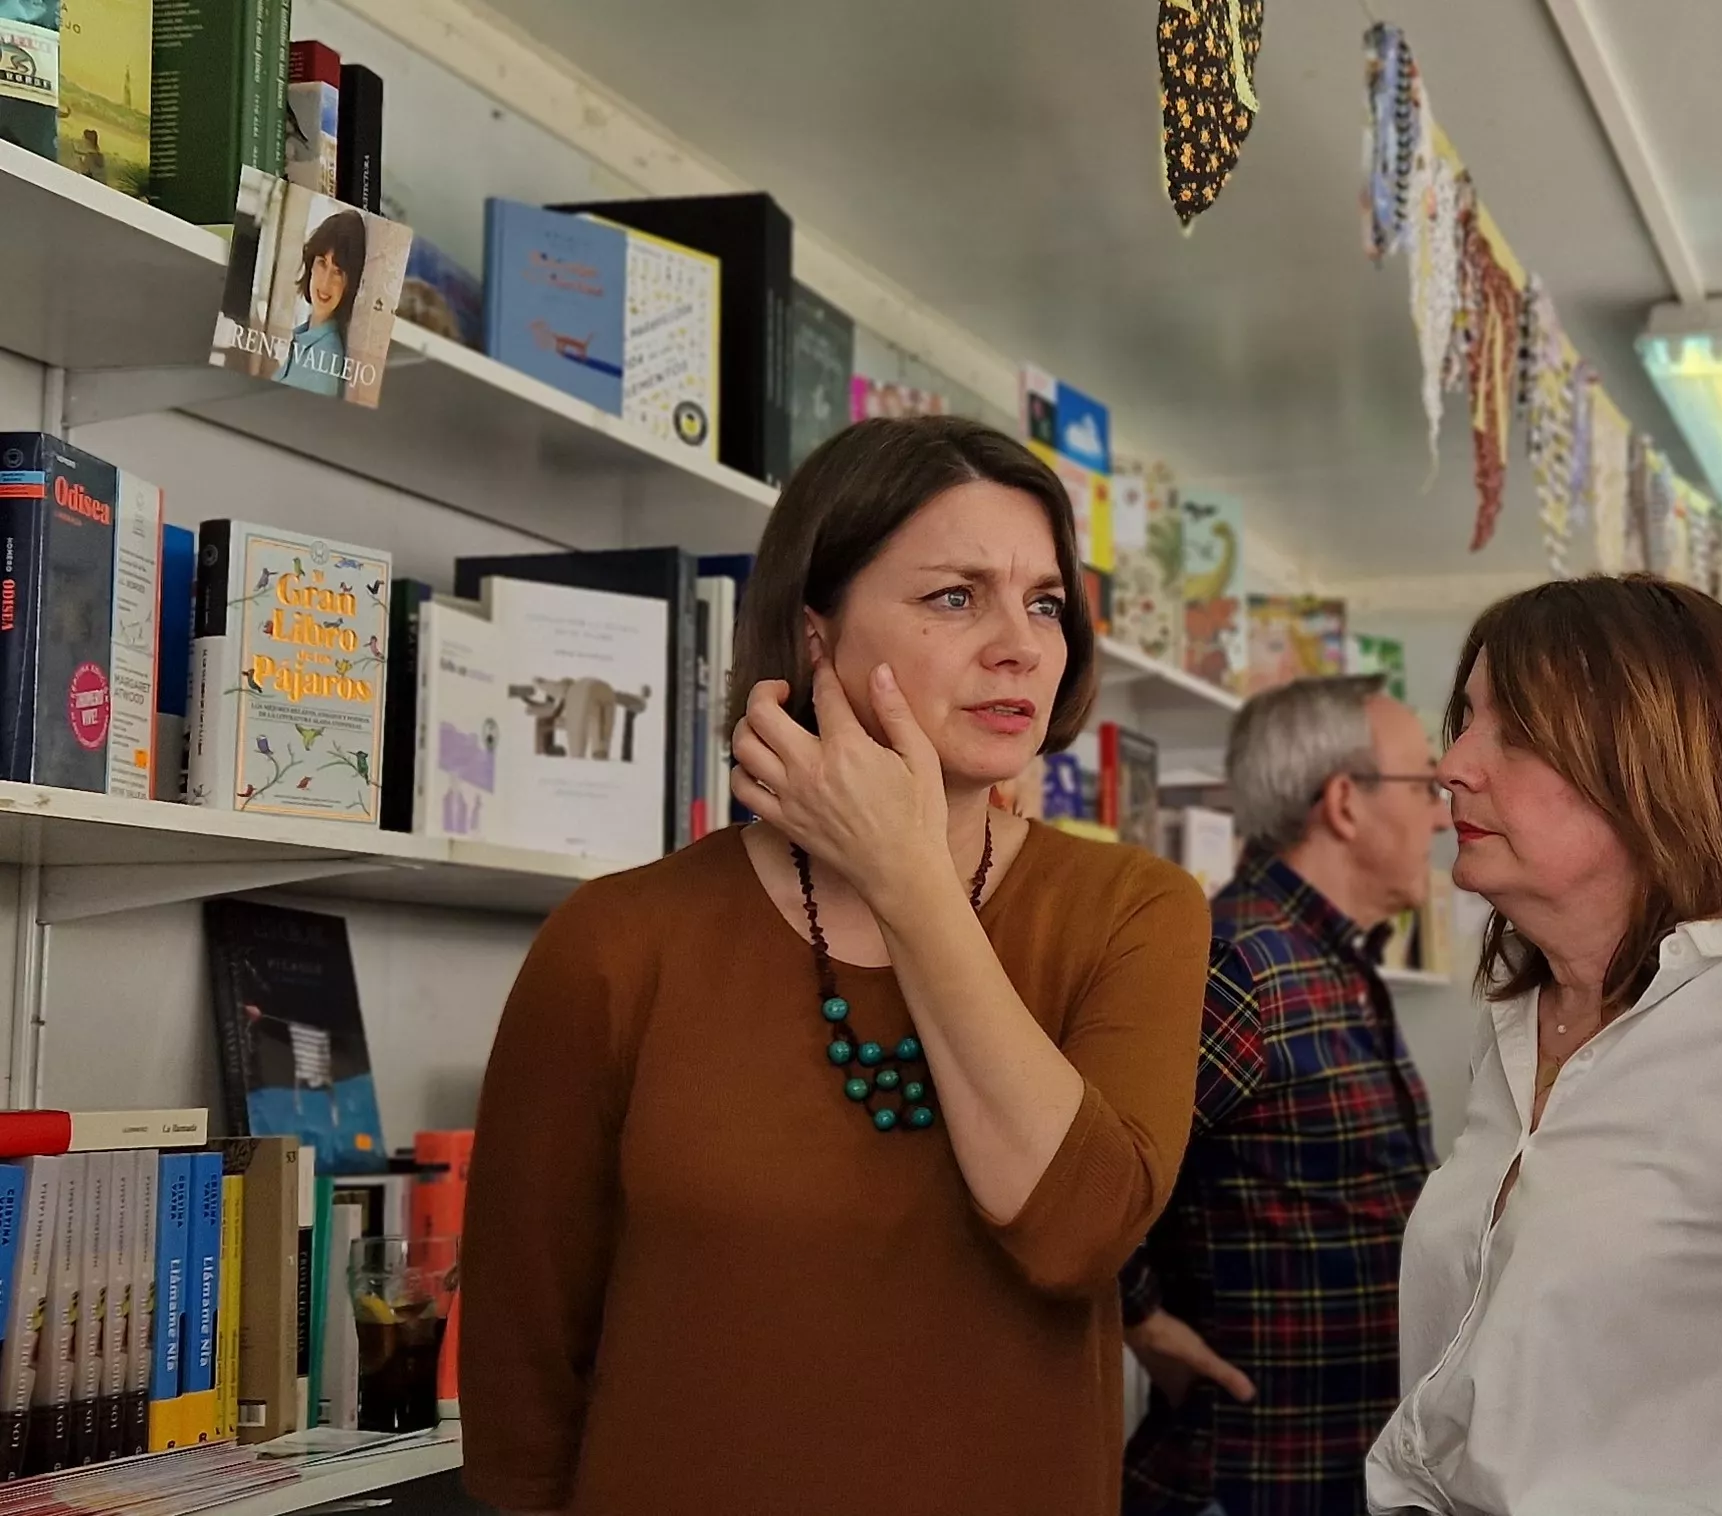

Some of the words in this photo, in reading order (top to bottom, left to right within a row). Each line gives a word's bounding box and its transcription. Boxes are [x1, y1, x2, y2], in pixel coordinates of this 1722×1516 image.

[292, 341, 377, 388] VALLEJO
[54, 475, 111, 525] Odisea
[5, 537, 14, 574] HOMERO
[1, 578, 16, 632] ODISEA
[276, 572, 357, 617] Gran
[271, 608, 359, 653] Libro
[251, 654, 373, 704] Pájaros
[1, 1188, 15, 1247] CRISTINA
[176, 1174, 185, 1229] CRISTINA
[209, 1173, 218, 1227] CRISTINA
[167, 1258, 182, 1339] Llámame
[201, 1255, 215, 1335] Llámame
